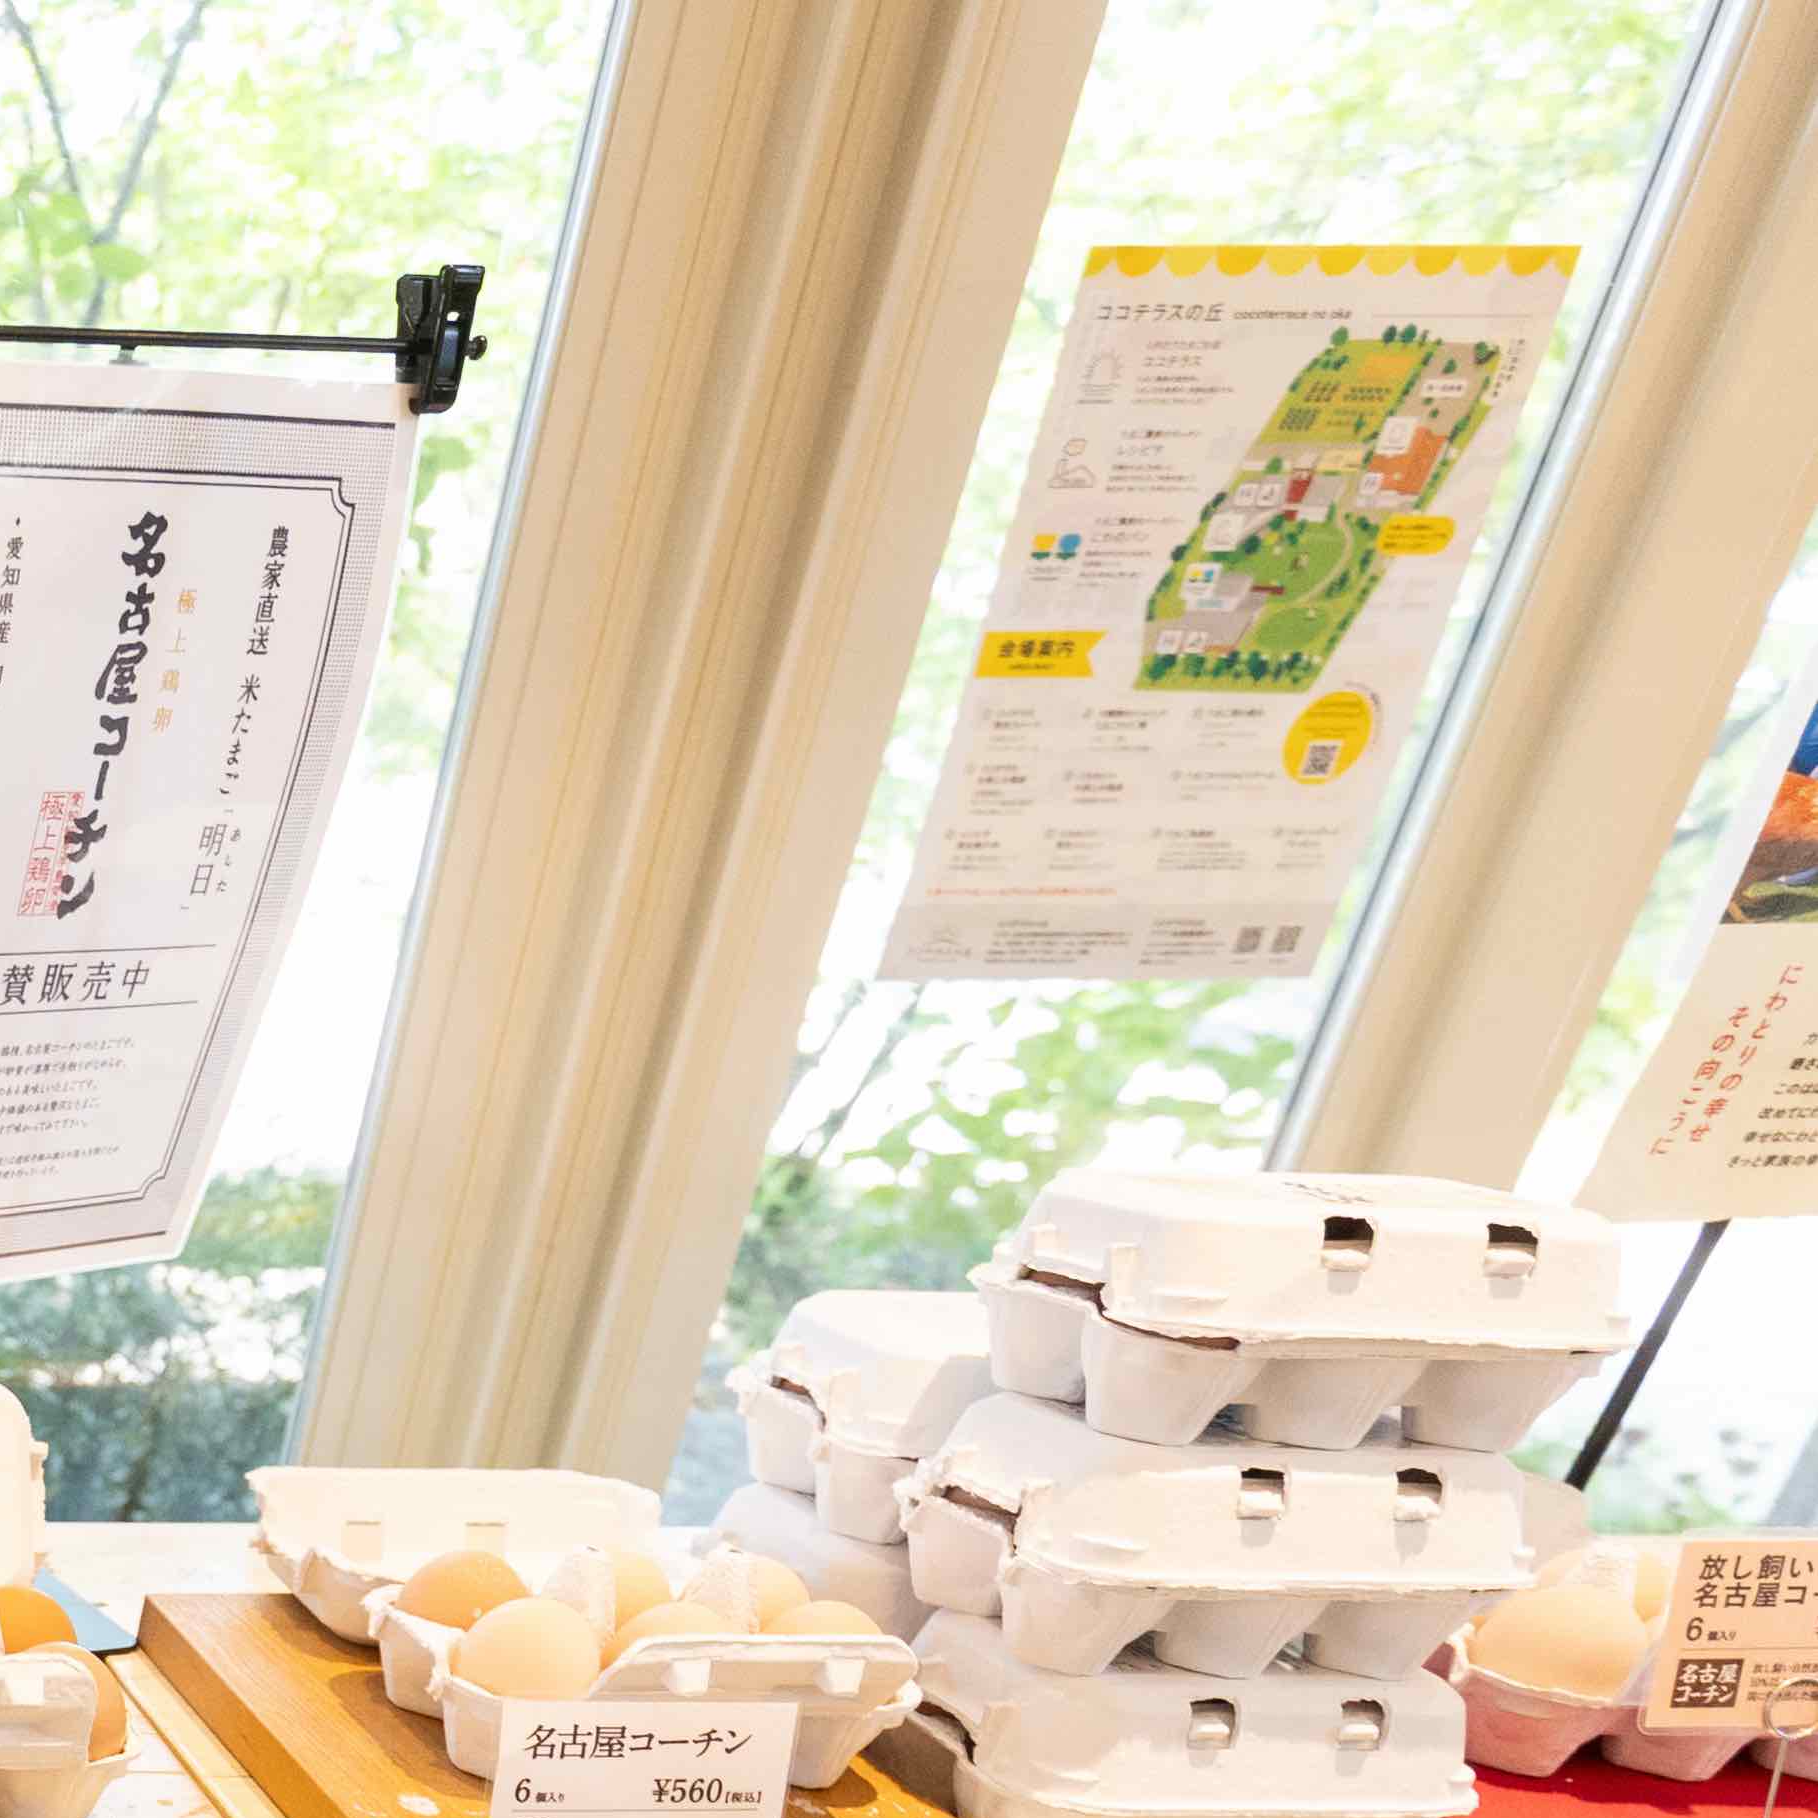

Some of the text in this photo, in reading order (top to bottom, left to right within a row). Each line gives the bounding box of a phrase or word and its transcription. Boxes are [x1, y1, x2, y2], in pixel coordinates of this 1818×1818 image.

[1096, 303, 1226, 323] ココテラスの丘
[151, 586, 197, 735] 極上鶏卵
[218, 525, 289, 797] 農家直送 米たまご
[56, 511, 171, 921] 名古屋コーチン
[1689, 964, 1804, 1142] にわとりの幸せ
[1649, 1005, 1750, 1156] その向こうに
[1698, 1553, 1815, 1582] 放し飼い
[1692, 1581, 1818, 1609] 名古屋コ
[1685, 1616, 1705, 1643] 6
[1678, 1662, 1740, 1685] 名古屋
[1673, 1684, 1736, 1705] コーチン
[524, 1723, 754, 1760] 名古屋コーチン
[514, 1777, 763, 1805] 6 ¥560 【税込】
